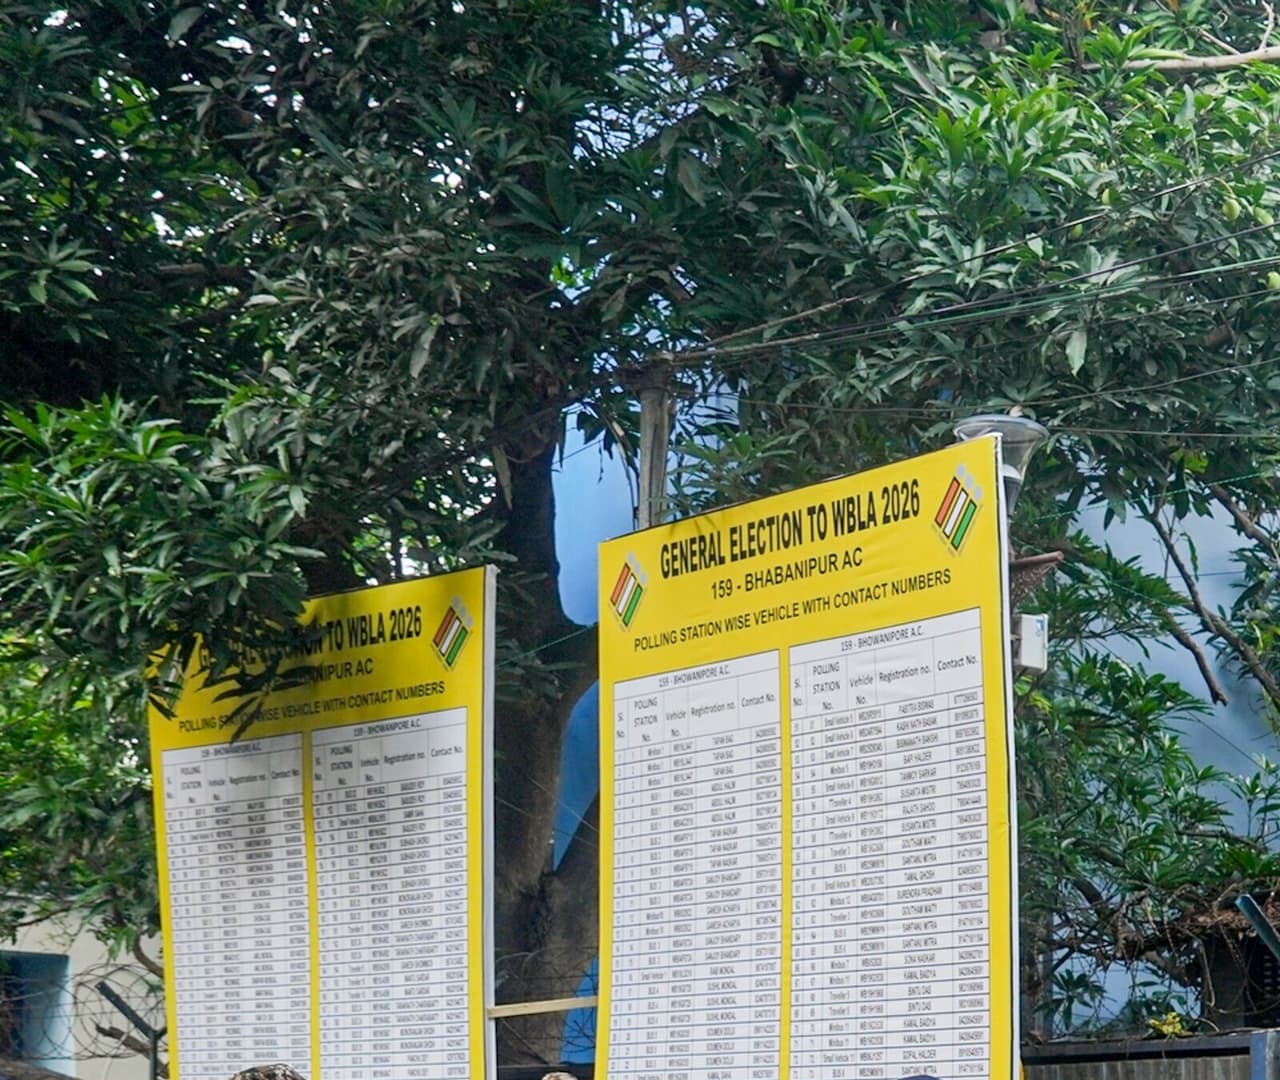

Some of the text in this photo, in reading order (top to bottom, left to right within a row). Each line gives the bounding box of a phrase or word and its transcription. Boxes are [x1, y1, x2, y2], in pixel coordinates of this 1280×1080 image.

[660, 479, 920, 580] GENERAL ELECTION TO WBLA 2026
[711, 580, 732, 600] 159
[745, 553, 839, 592] BHABANIPUR
[842, 546, 863, 569] AC
[326, 625, 344, 649] TO
[346, 611, 386, 646] WBLA
[389, 606, 422, 639] 2026
[634, 569, 951, 651] POLLING STATION WISE VEHICLE WITH CONTACT NUMBERS
[355, 658, 373, 676] AC
[937, 659, 964, 671] Contact
[179, 717, 216, 733] POLLING
[347, 689, 394, 709] CONTACT
[396, 681, 445, 701] NUMBERS
